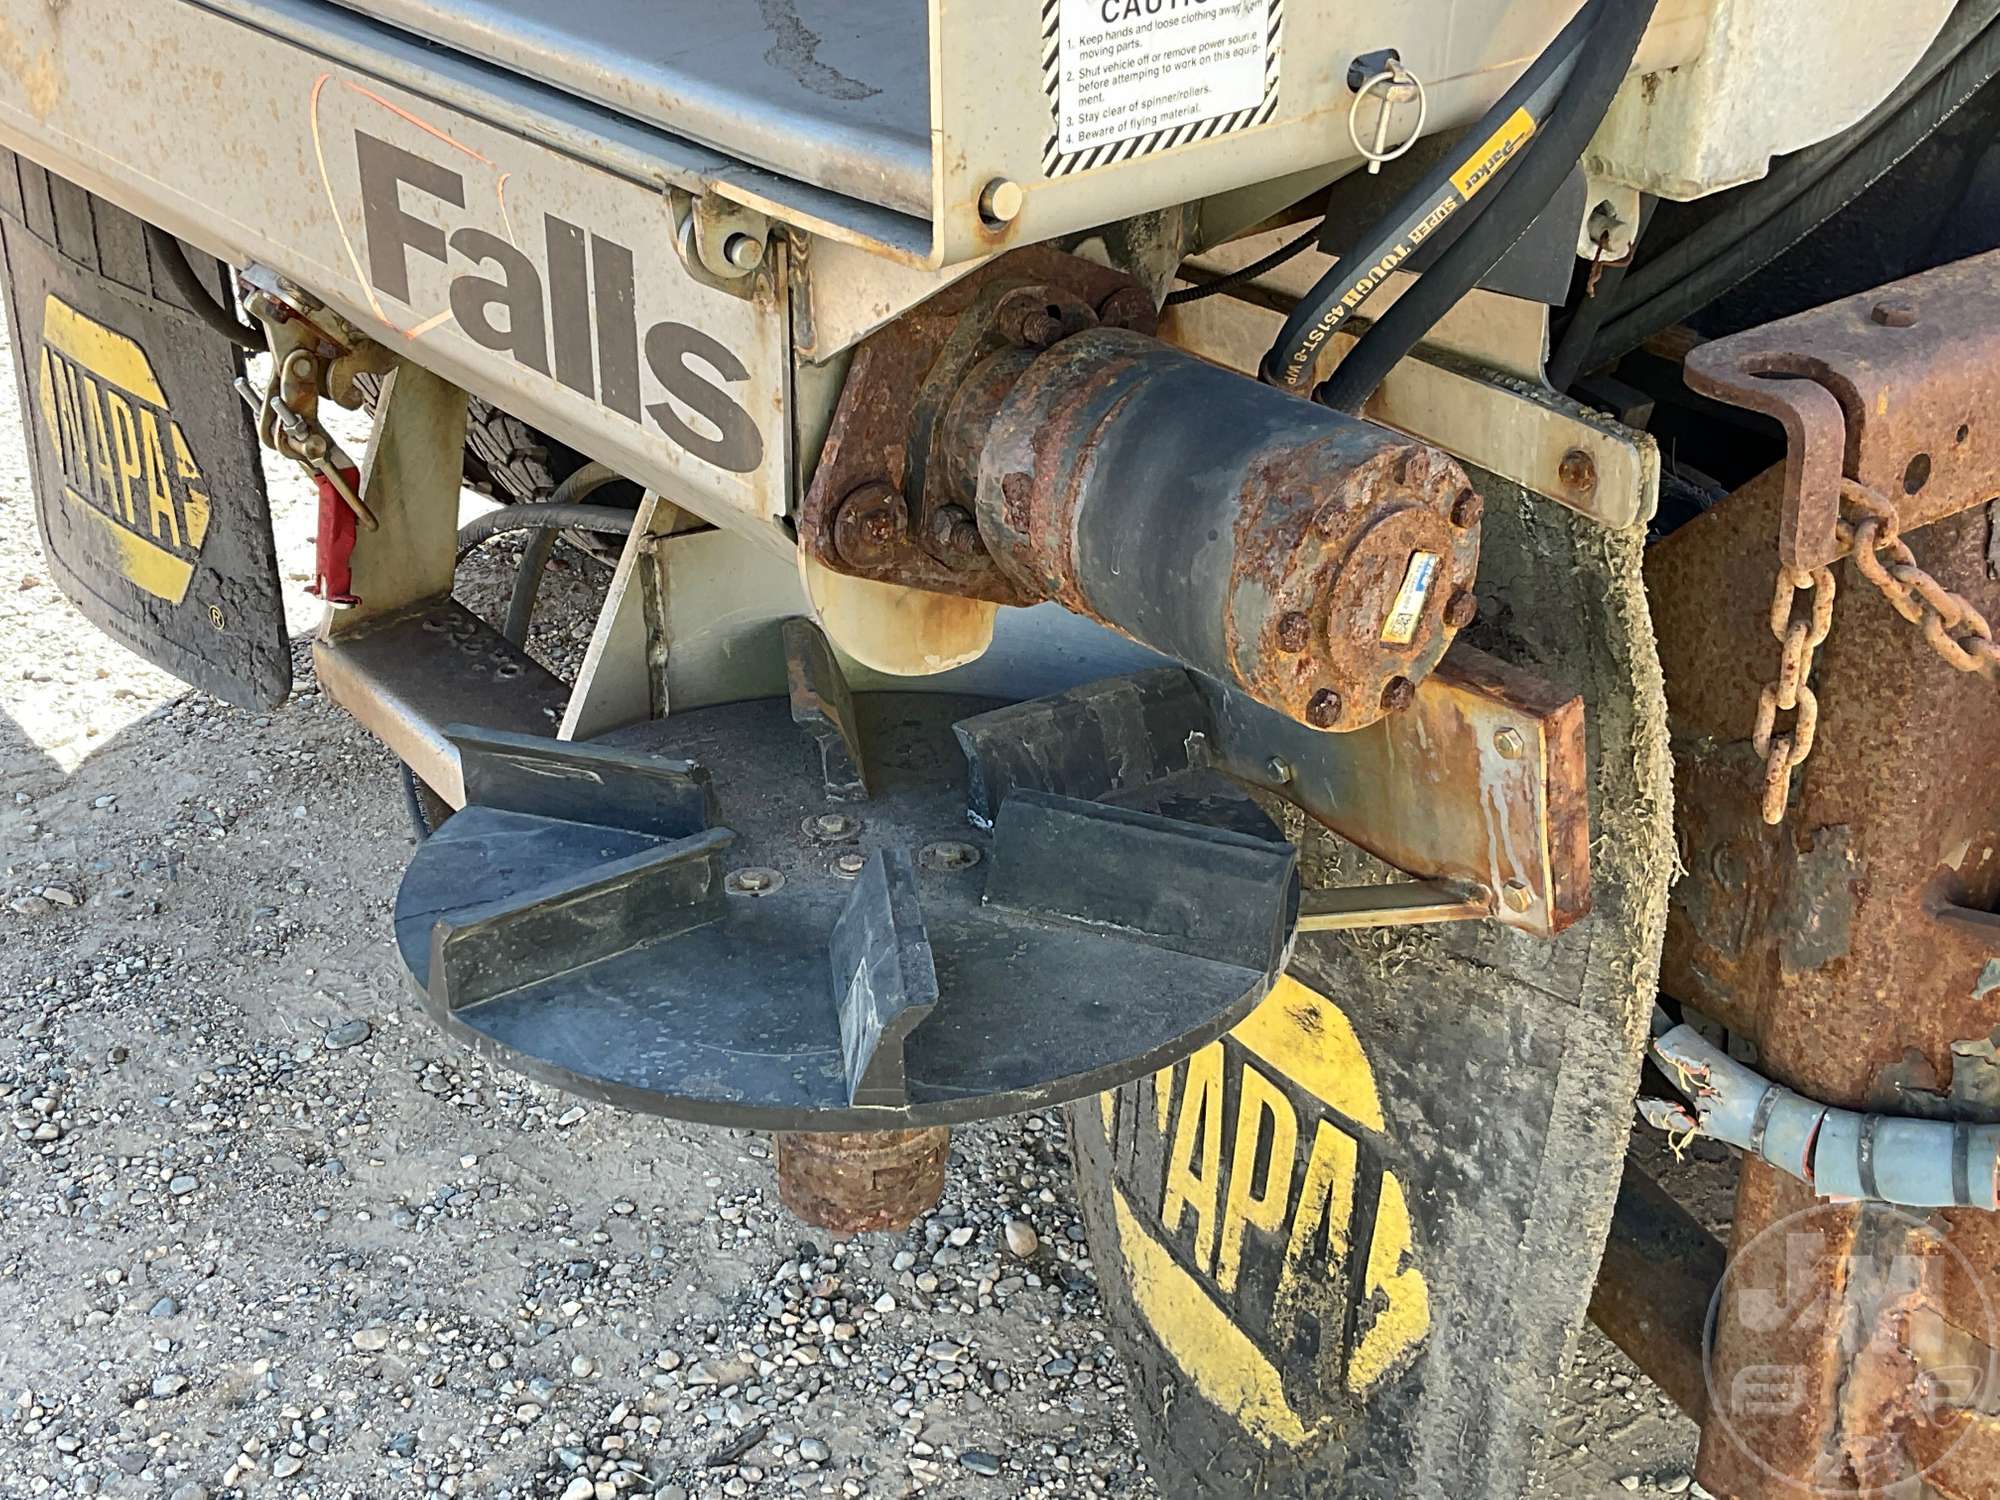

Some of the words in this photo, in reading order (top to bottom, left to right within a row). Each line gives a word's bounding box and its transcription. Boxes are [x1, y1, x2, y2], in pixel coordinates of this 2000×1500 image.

[1067, 39, 1076, 49] 1.
[1079, 33, 1104, 47] Keep
[1105, 27, 1133, 40] hands
[1135, 21, 1153, 34] and
[1154, 18, 1180, 29] loose
[1181, 8, 1217, 24] clothing
[1219, 3, 1241, 16] away
[1066, 71, 1076, 82] 2.
[1079, 65, 1101, 79] Shut
[1102, 59, 1136, 73] vehicle
[1136, 53, 1150, 66] off
[1151, 53, 1161, 63] or
[1163, 45, 1197, 60] remove
[1199, 38, 1226, 53] power
[1078, 79, 1110, 92] before
[1162, 64, 1172, 73] to
[1174, 57, 1197, 71] work
[1199, 55, 1211, 65] on
[1213, 50, 1231, 62] this
[1079, 45, 1115, 61] moving
[1116, 38, 1143, 55] parts.
[1065, 116, 1075, 127] 3.
[1078, 111, 1101, 125] Stay
[1102, 105, 1126, 118] clear
[1128, 99, 1139, 112] of
[1078, 92, 1105, 107] ment.
[1065, 133, 1075, 145] 4.
[1078, 126, 1115, 141] Beware
[1117, 120, 1127, 132] of
[1130, 114, 1158, 129] flying
[1160, 102, 1202, 121] material.
[1464, 137, 1518, 191] Parker
[1407, 195, 1459, 245] SUPER
[1340, 243, 1412, 308] TOUGH
[354, 129, 764, 473] Falls
[1294, 304, 1346, 363] 451ST-8
[1284, 363, 1303, 386] WP
[52, 348, 181, 549] NAPA
